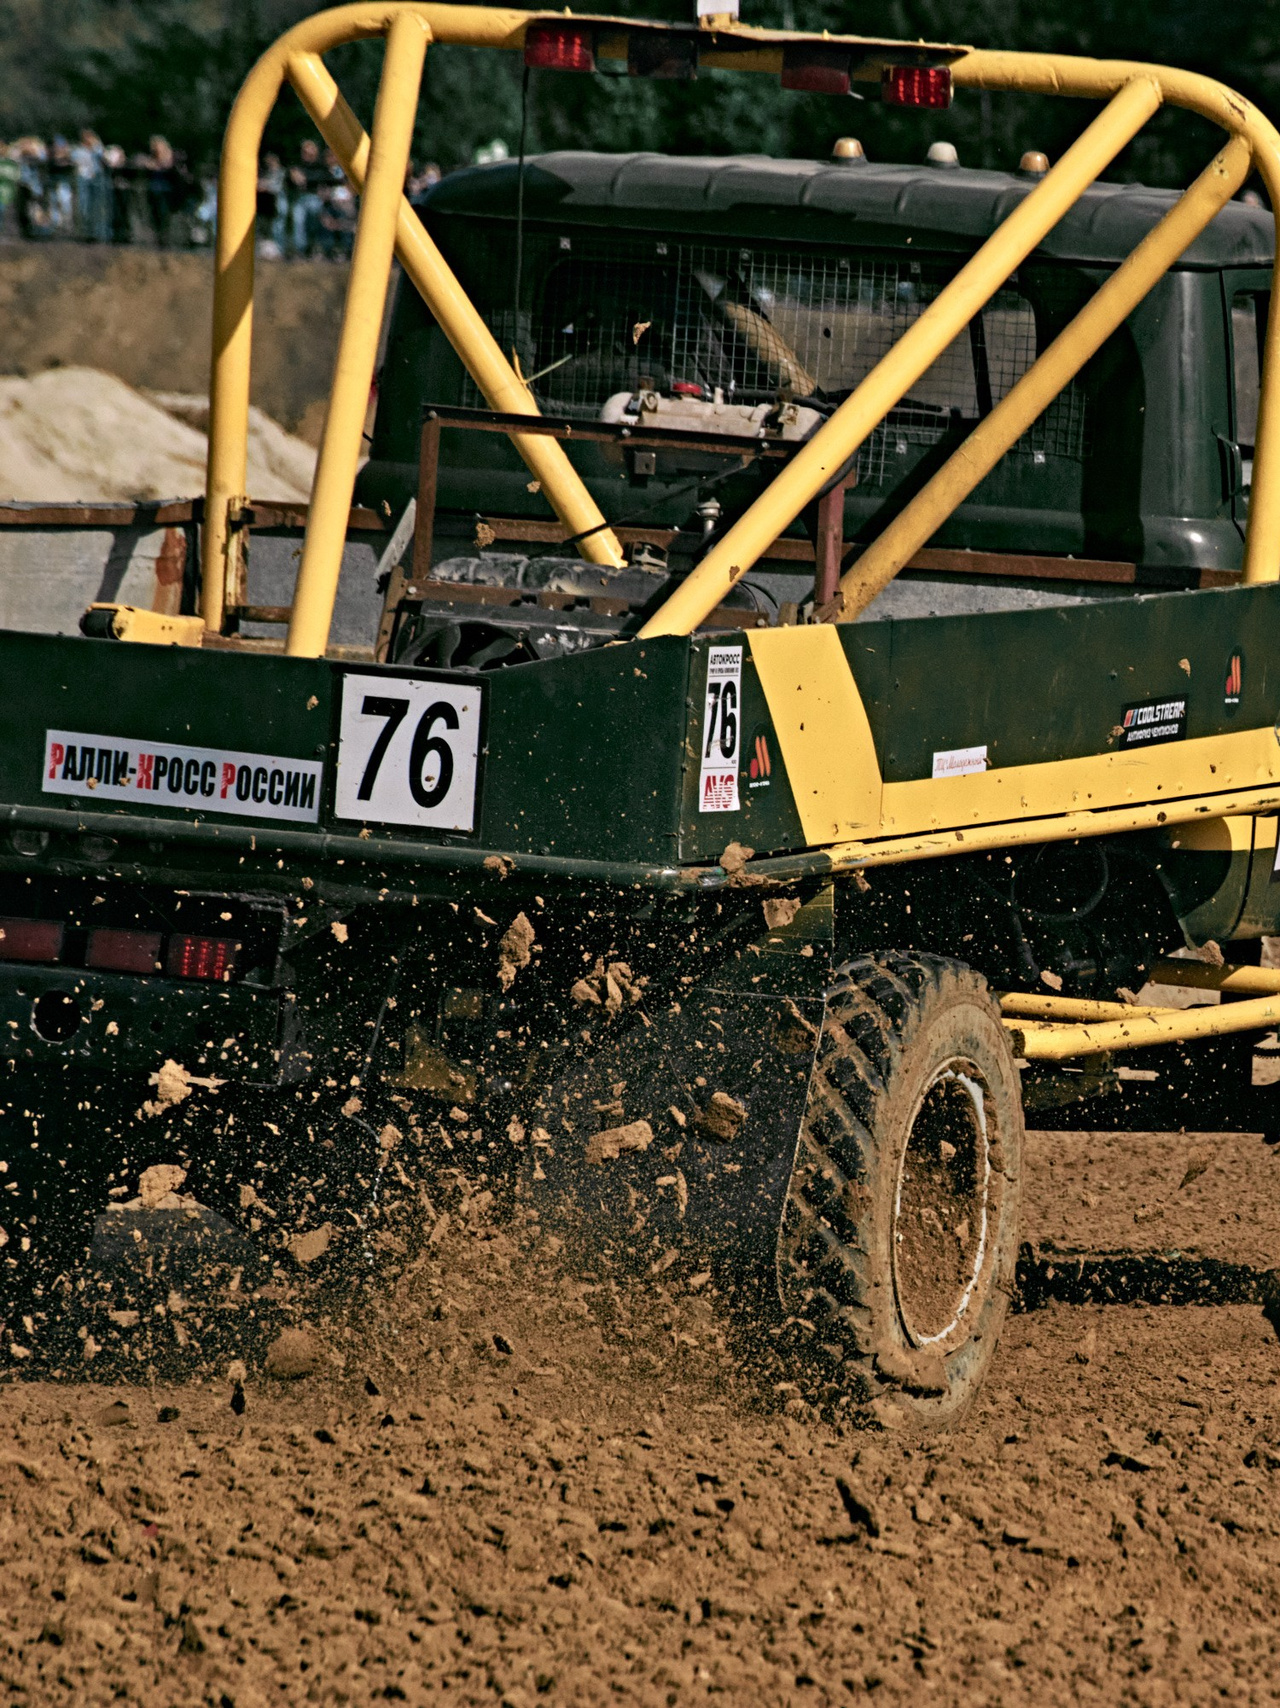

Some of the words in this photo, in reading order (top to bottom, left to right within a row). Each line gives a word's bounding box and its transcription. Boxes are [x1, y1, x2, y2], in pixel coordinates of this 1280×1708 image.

[710, 653, 740, 665] АВТОКРОСС
[705, 681, 737, 758] 76
[1137, 701, 1185, 725] COOLSTREAM
[48, 742, 216, 798] РАЛЛИ-КРОСС
[220, 762, 317, 810] РОССИИ
[357, 695, 460, 809] 76
[703, 774, 735, 809] AVS
